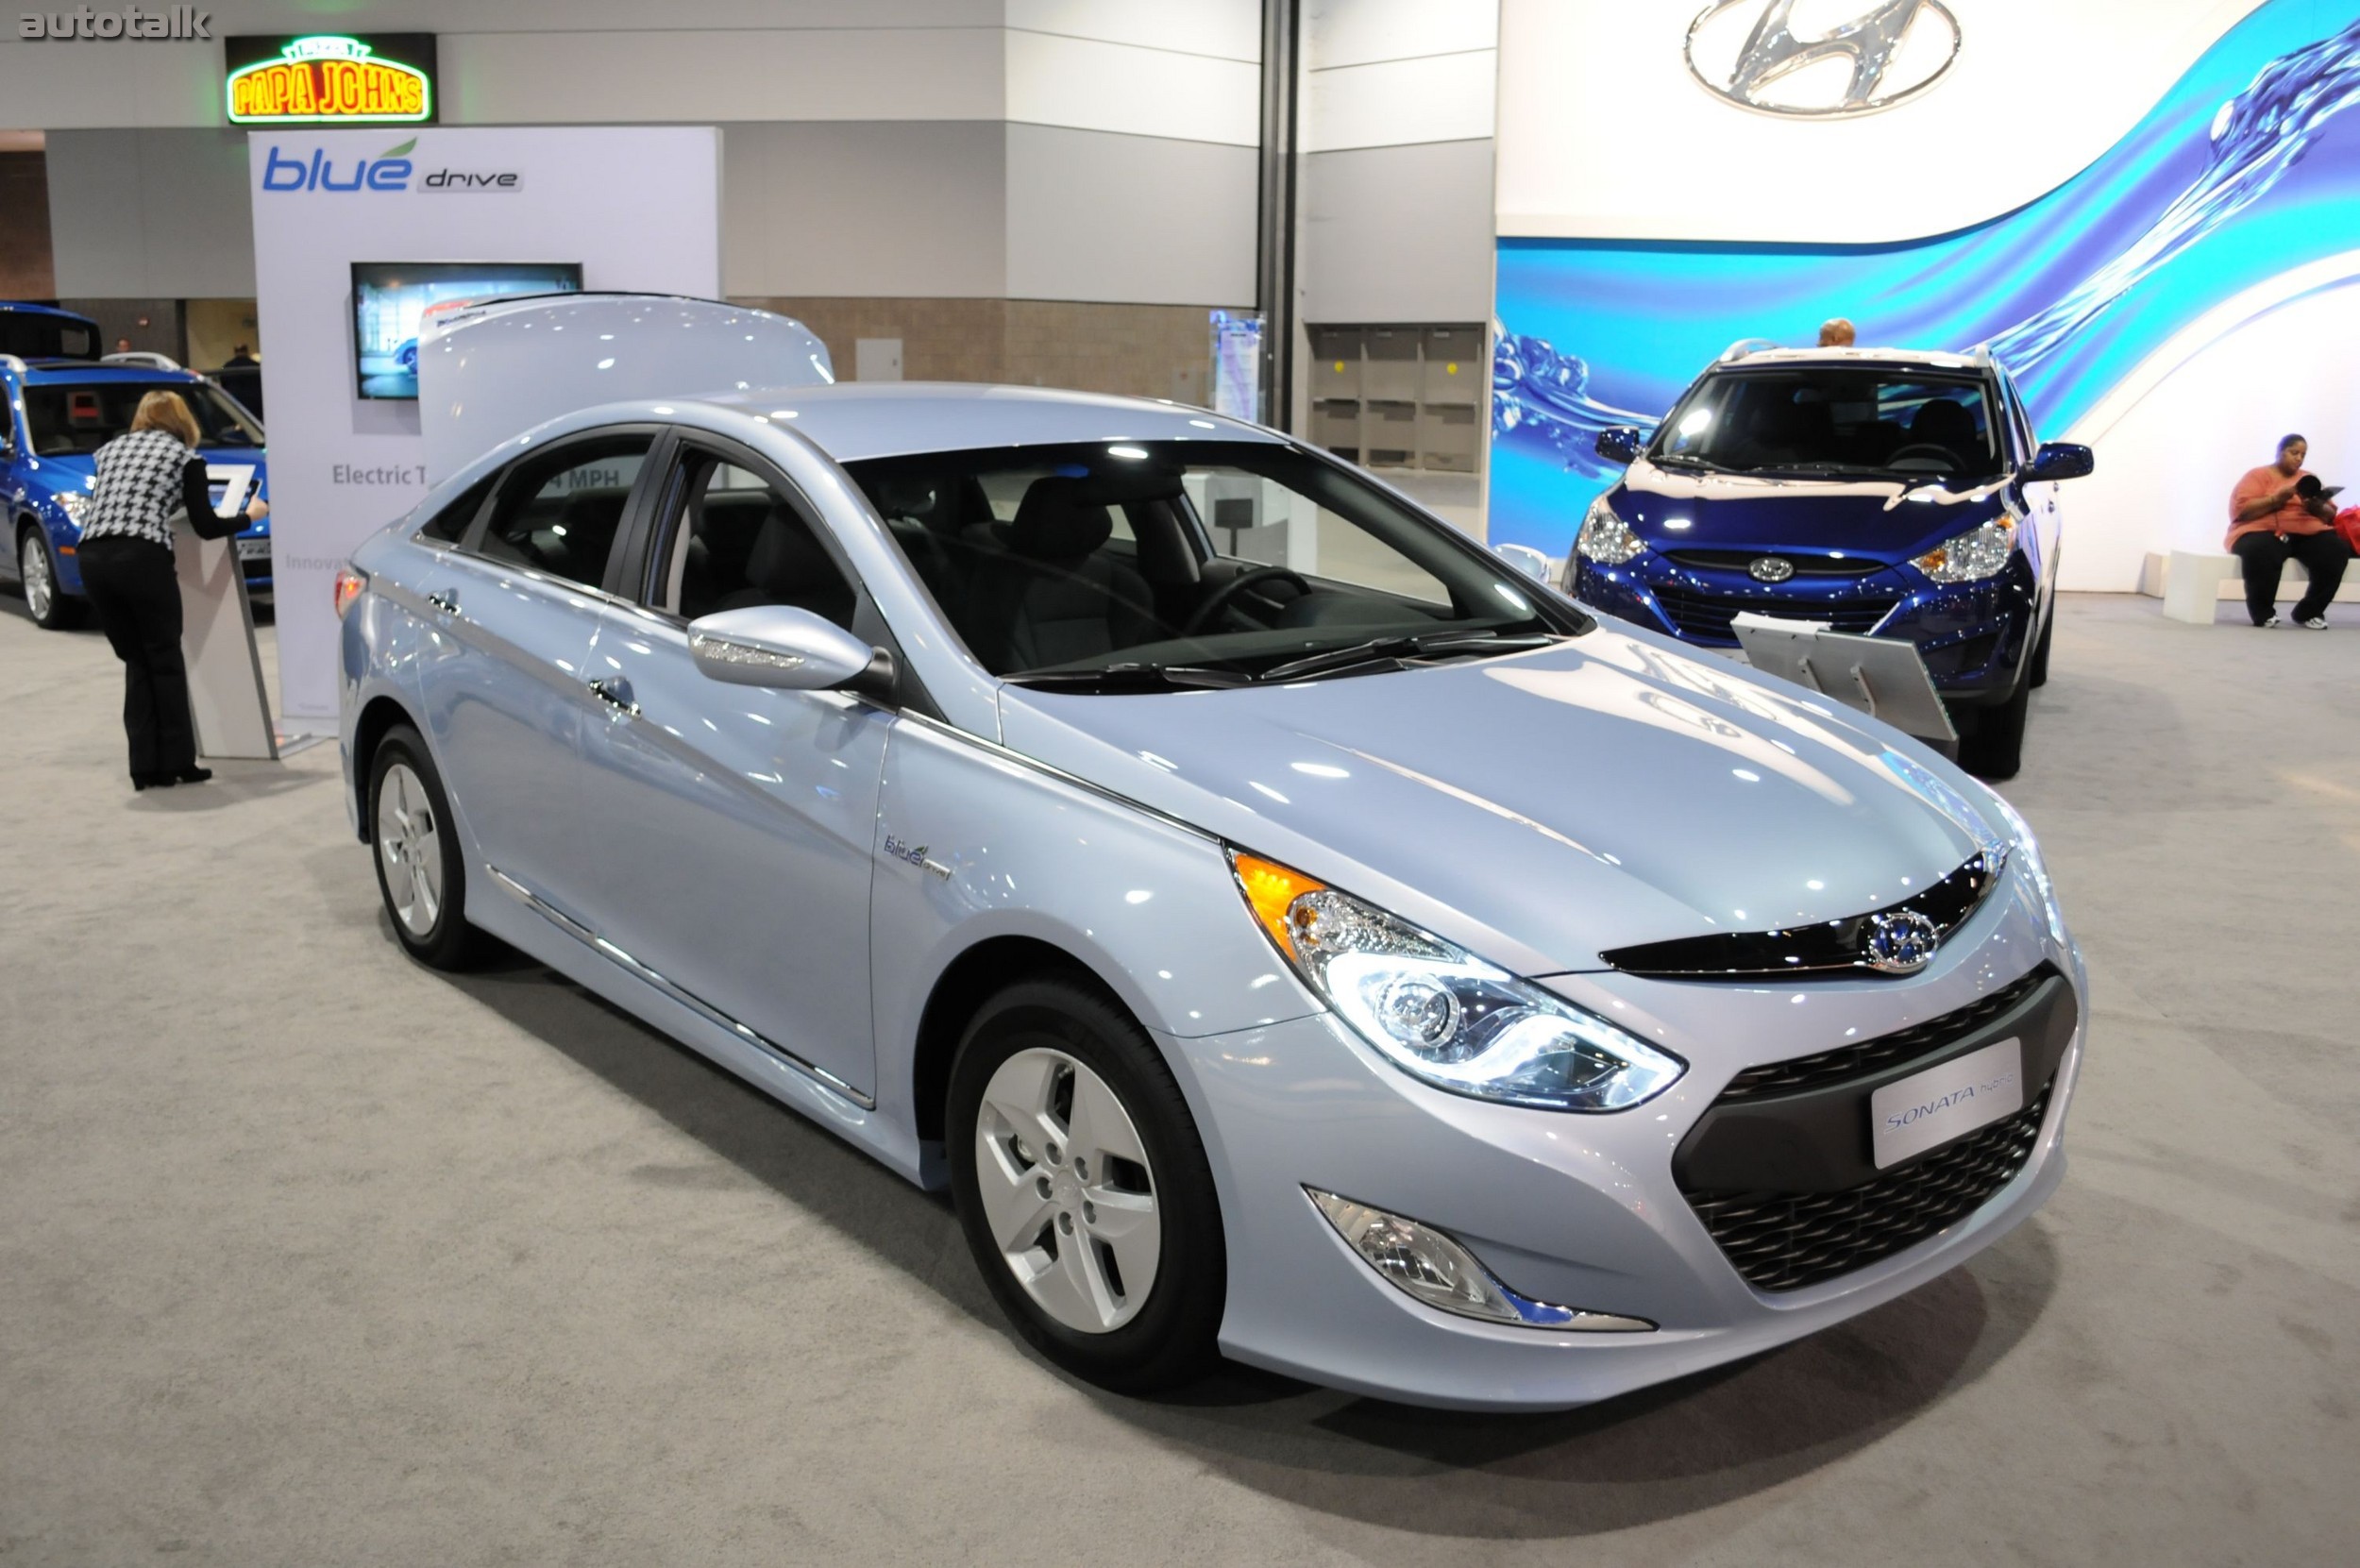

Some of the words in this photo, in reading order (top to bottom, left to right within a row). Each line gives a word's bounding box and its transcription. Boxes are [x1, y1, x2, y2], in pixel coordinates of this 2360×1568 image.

[233, 63, 315, 114] PAPA
[263, 146, 413, 191] blue
[426, 168, 518, 187] drive
[332, 464, 411, 484] Electric
[568, 468, 619, 488] MPH
[1886, 1087, 1975, 1132] SONATA
